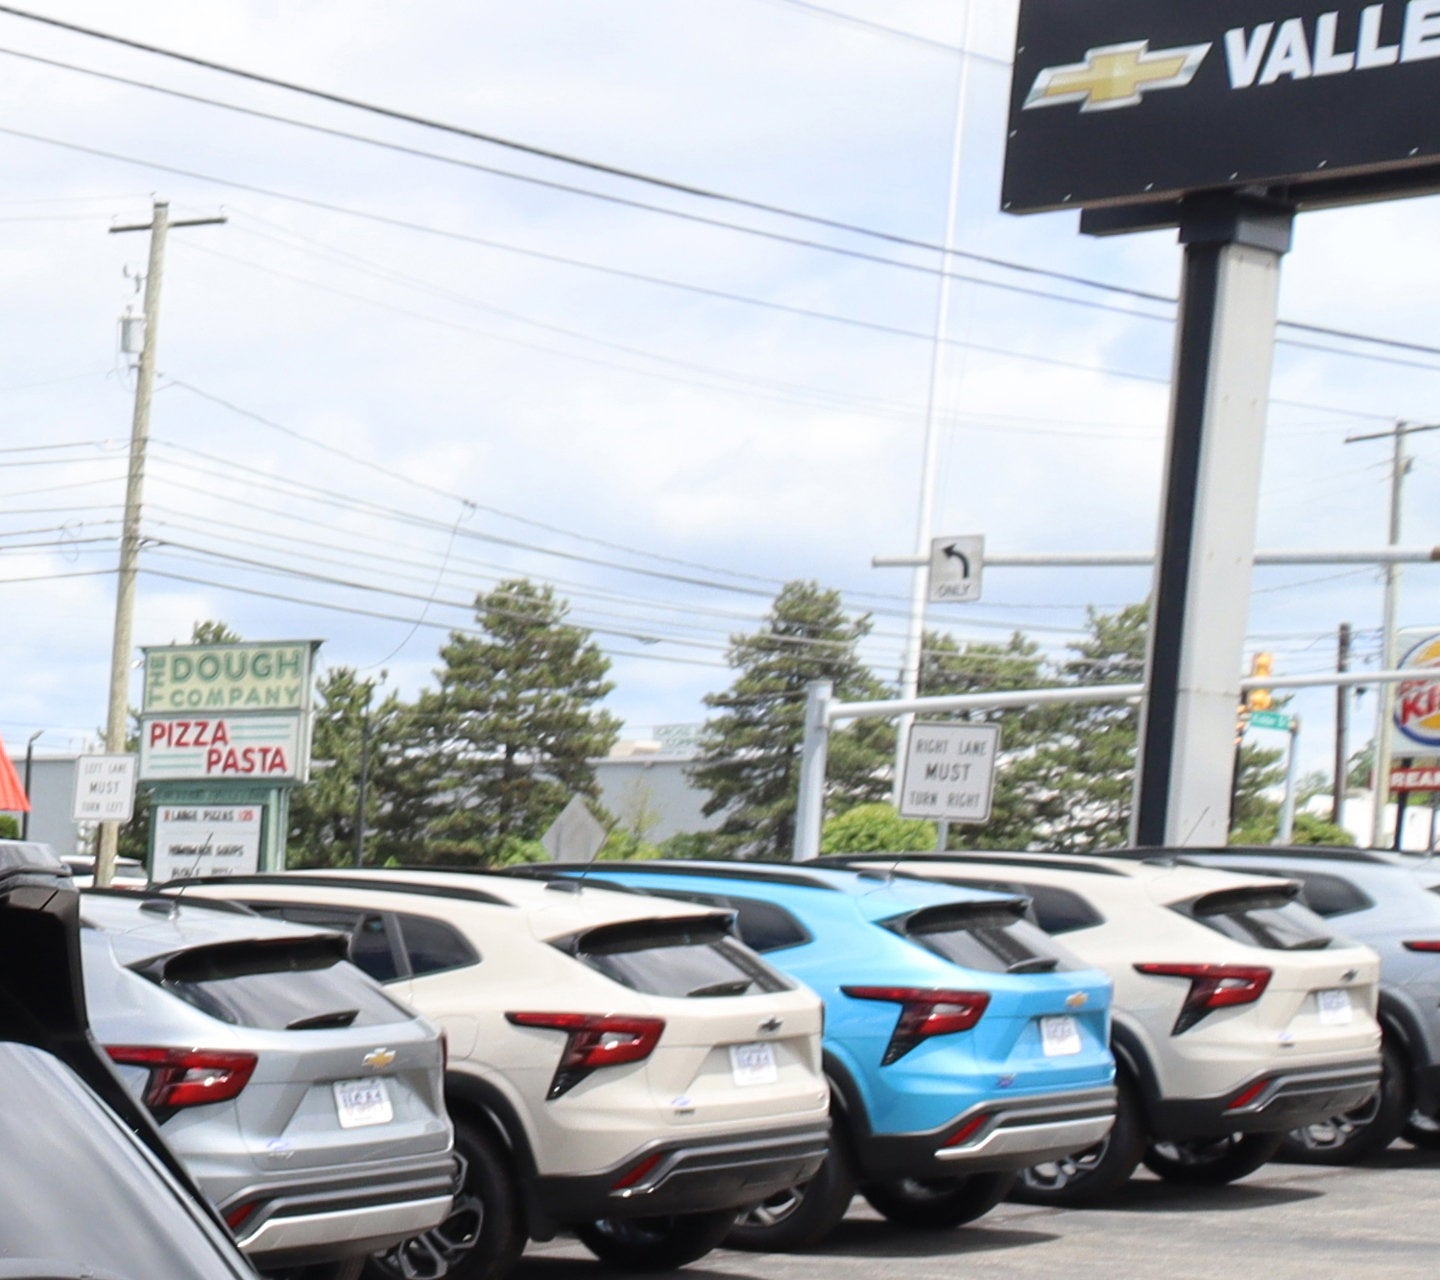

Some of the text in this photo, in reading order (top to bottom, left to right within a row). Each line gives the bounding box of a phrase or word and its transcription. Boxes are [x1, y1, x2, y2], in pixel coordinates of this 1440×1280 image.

[170, 650, 302, 683] DOUGH
[148, 656, 166, 707] THE
[169, 685, 300, 707] COMPANY
[150, 720, 229, 748] PIZZA
[916, 738, 987, 756] RIGHT LANE
[206, 747, 288, 774] PASTA
[925, 763, 972, 781] MUST
[89, 781, 121, 795] MUST
[909, 790, 981, 808] TURN RIGHT
